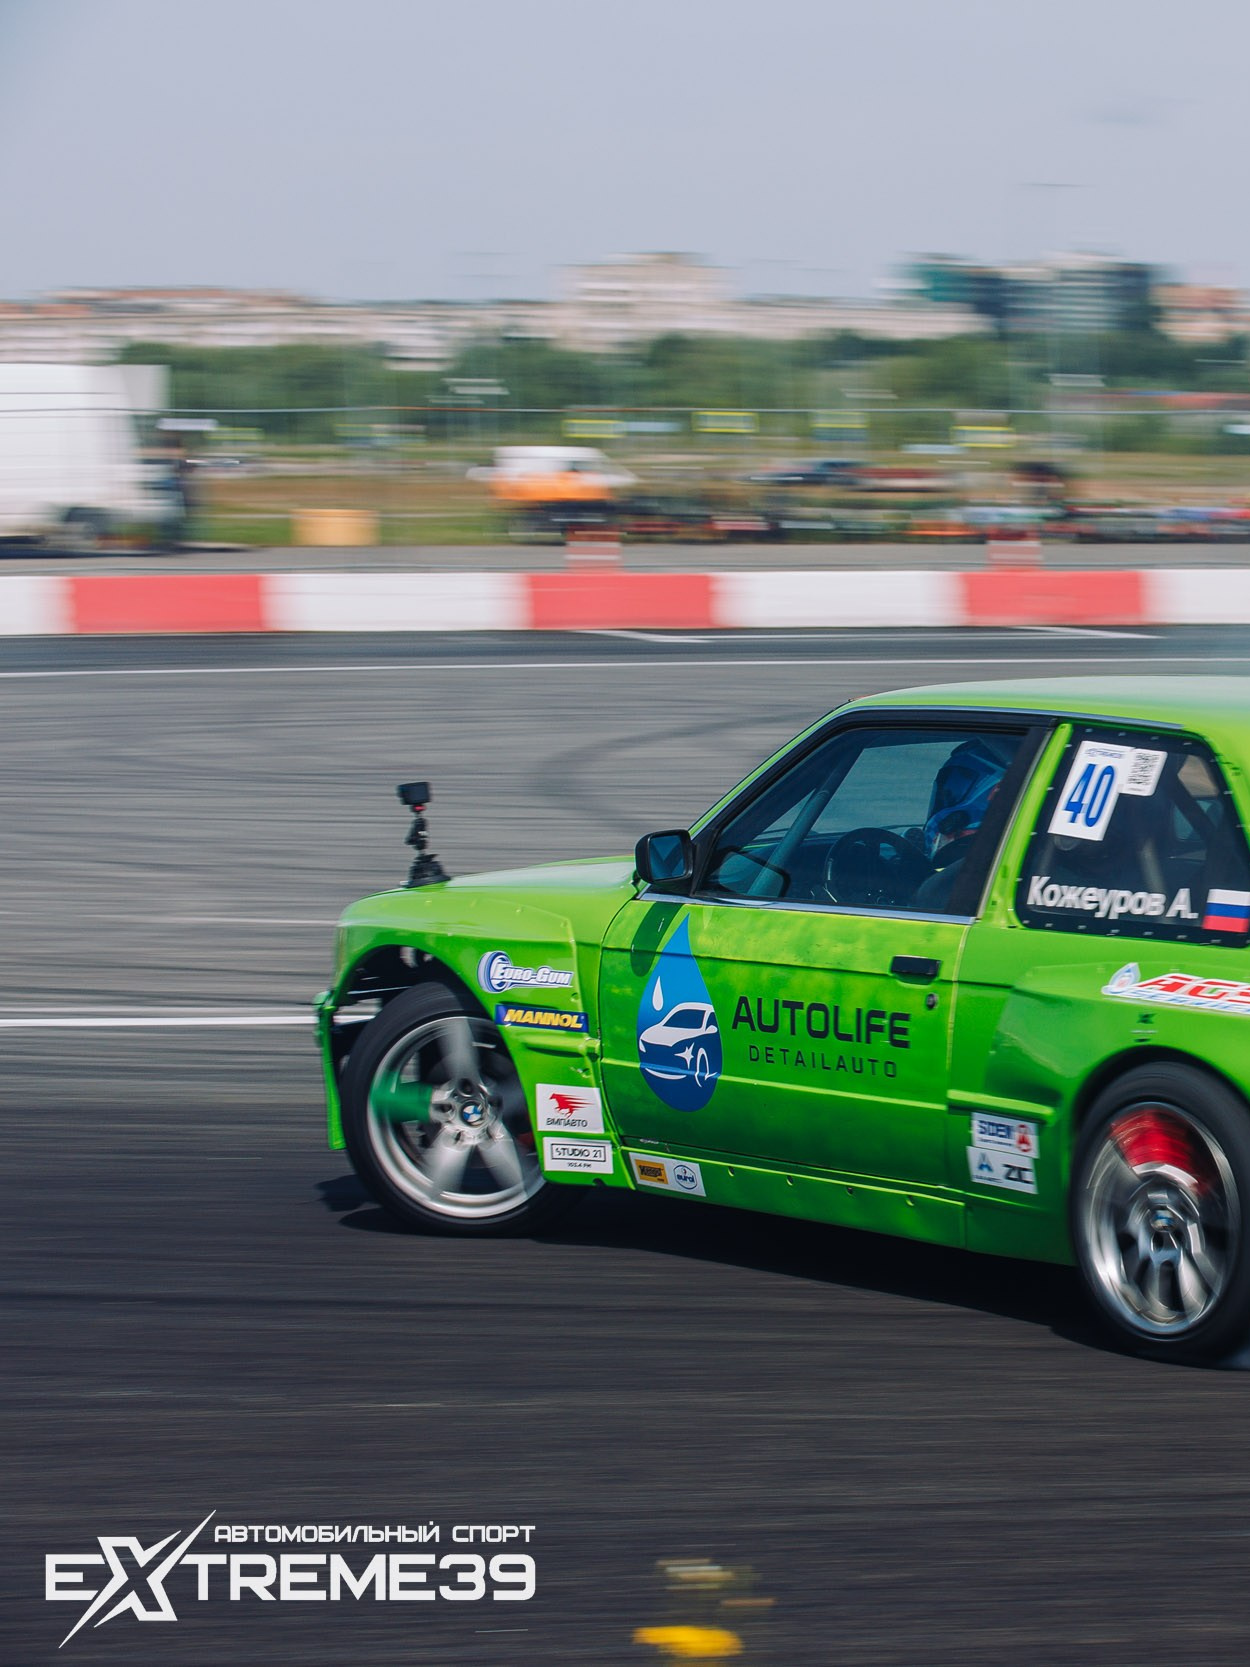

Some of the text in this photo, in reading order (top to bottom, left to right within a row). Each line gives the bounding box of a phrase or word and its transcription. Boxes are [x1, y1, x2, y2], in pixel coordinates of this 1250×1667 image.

[1064, 763, 1115, 827] 40
[1026, 876, 1199, 919] Кожеуров А.
[503, 1009, 583, 1029] MANNOL
[732, 996, 911, 1049] AUTOLIFE
[749, 1045, 897, 1078] DETAILAUTO
[555, 1147, 602, 1159] STUDIO 21
